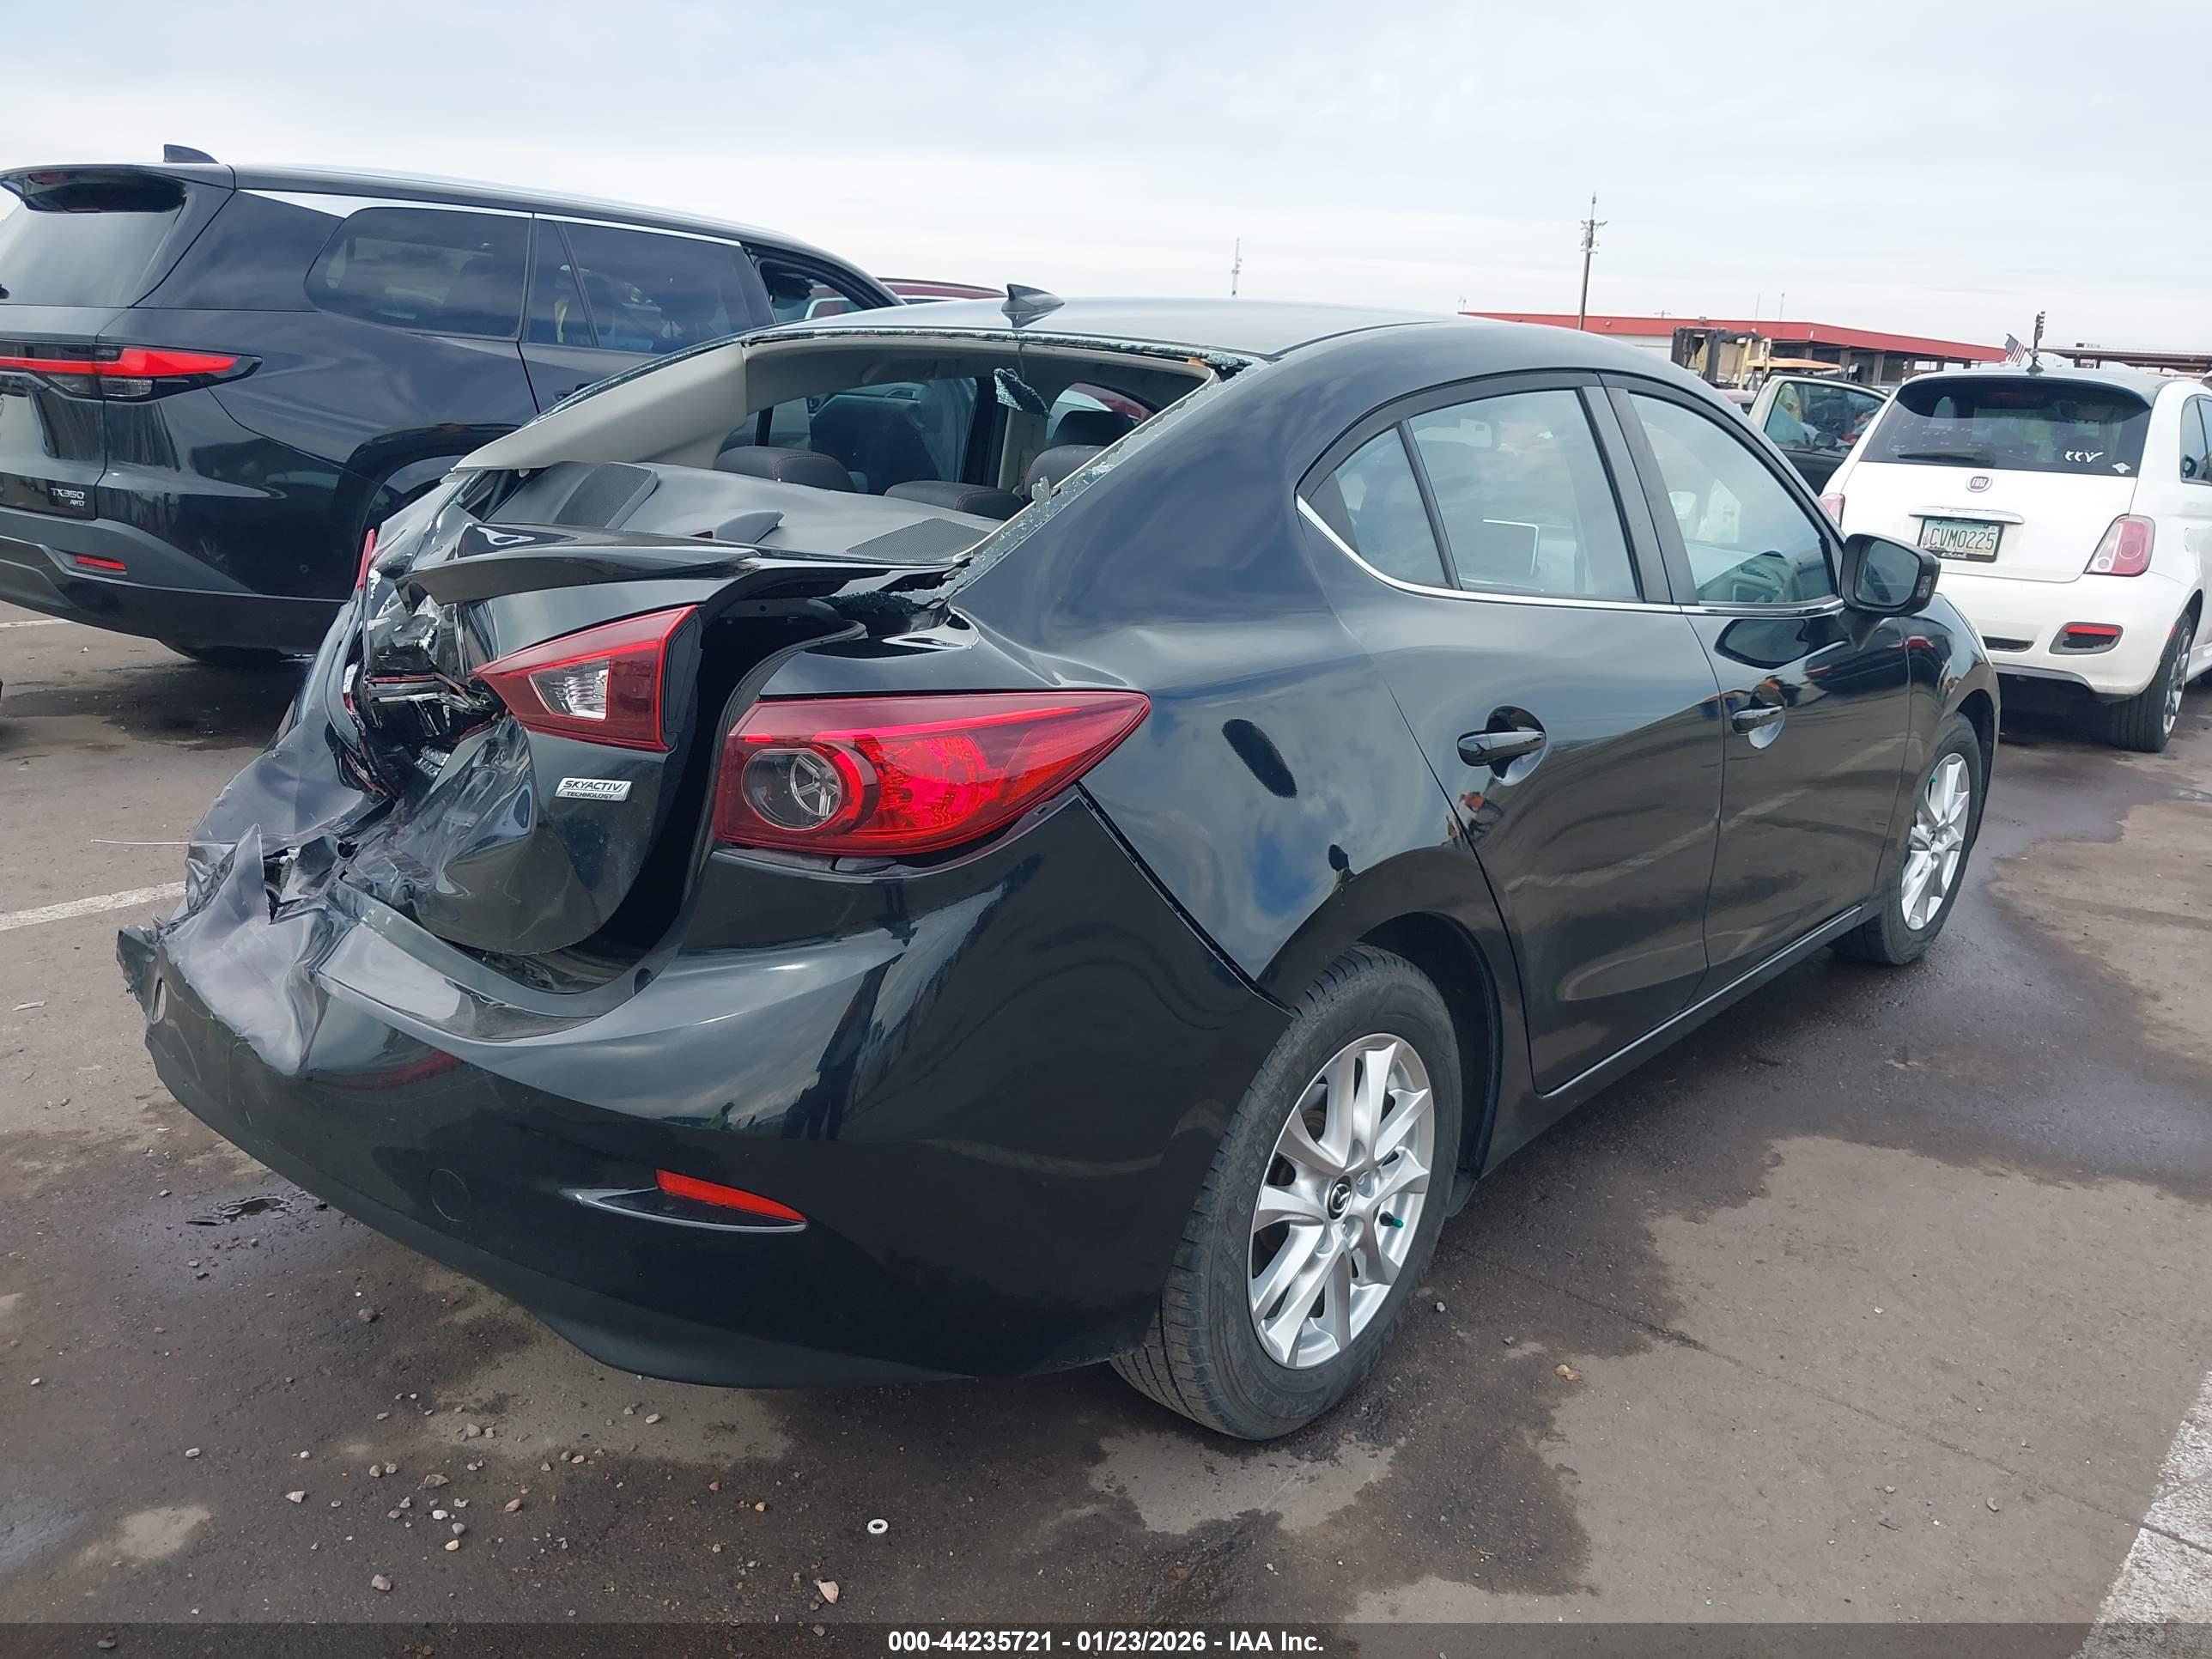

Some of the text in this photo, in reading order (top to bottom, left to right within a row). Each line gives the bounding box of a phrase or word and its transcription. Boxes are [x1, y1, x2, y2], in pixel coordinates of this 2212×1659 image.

[1971, 477, 1989, 488] FIAT
[50, 487, 85, 500] TX350
[1929, 527, 1996, 550] CVM0225
[563, 780, 623, 791] SKYACTIV
[567, 791, 615, 799] TECHNOLOGY
